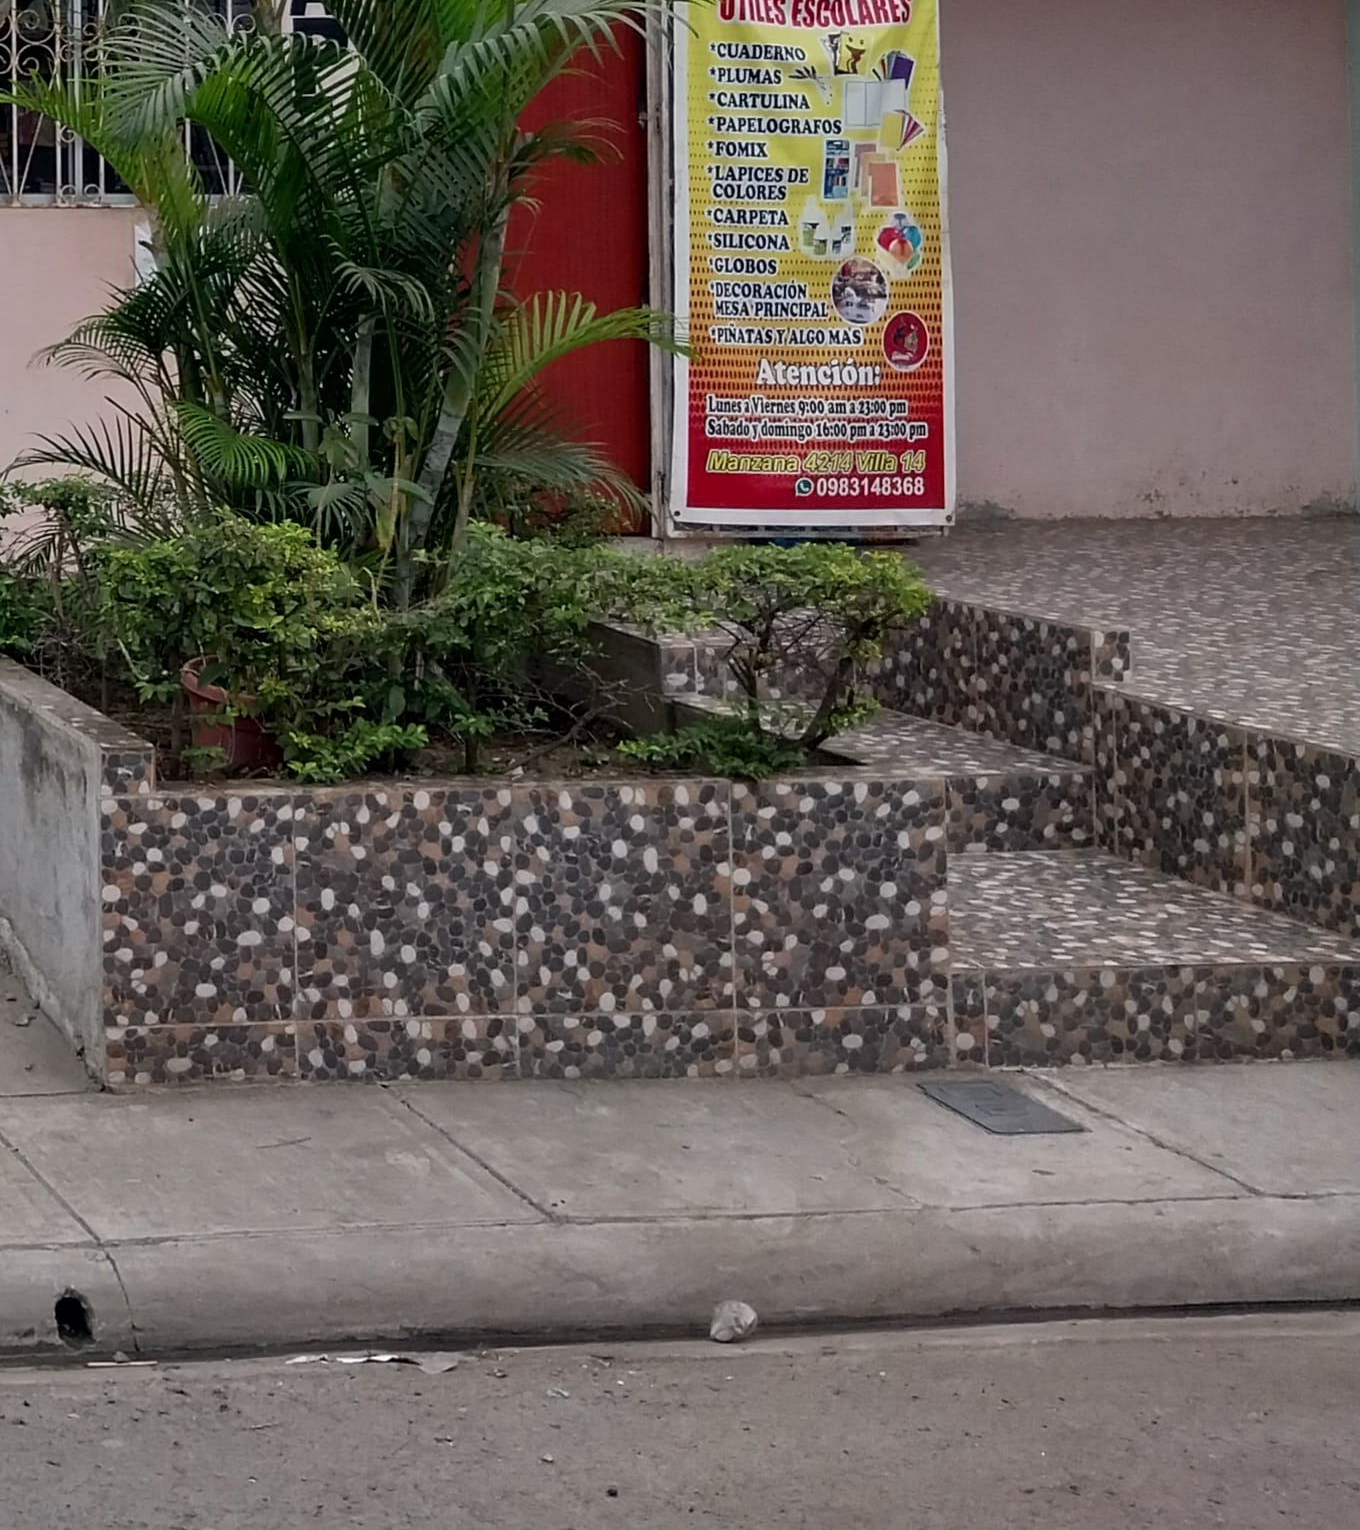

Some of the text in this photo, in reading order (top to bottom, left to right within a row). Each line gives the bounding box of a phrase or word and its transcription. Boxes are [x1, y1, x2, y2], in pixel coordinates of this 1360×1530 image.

[788, 168, 809, 183] DE
[712, 183, 787, 200] COLORES
[715, 300, 829, 318] MESA PRINCIPAL
[776, 329, 785, 344] Y
[788, 329, 825, 344] ALGO
[829, 329, 862, 344] MAS
[755, 357, 881, 385] Atención:
[708, 396, 907, 417] Lunes a Viernes 9:00 am a 23:00 pm
[707, 419, 926, 441] Sabado y domingo 16:00 pm a 23:00 pm
[708, 451, 925, 472] Manzana 4214 Villa 14
[816, 477, 925, 496] 0983148368
